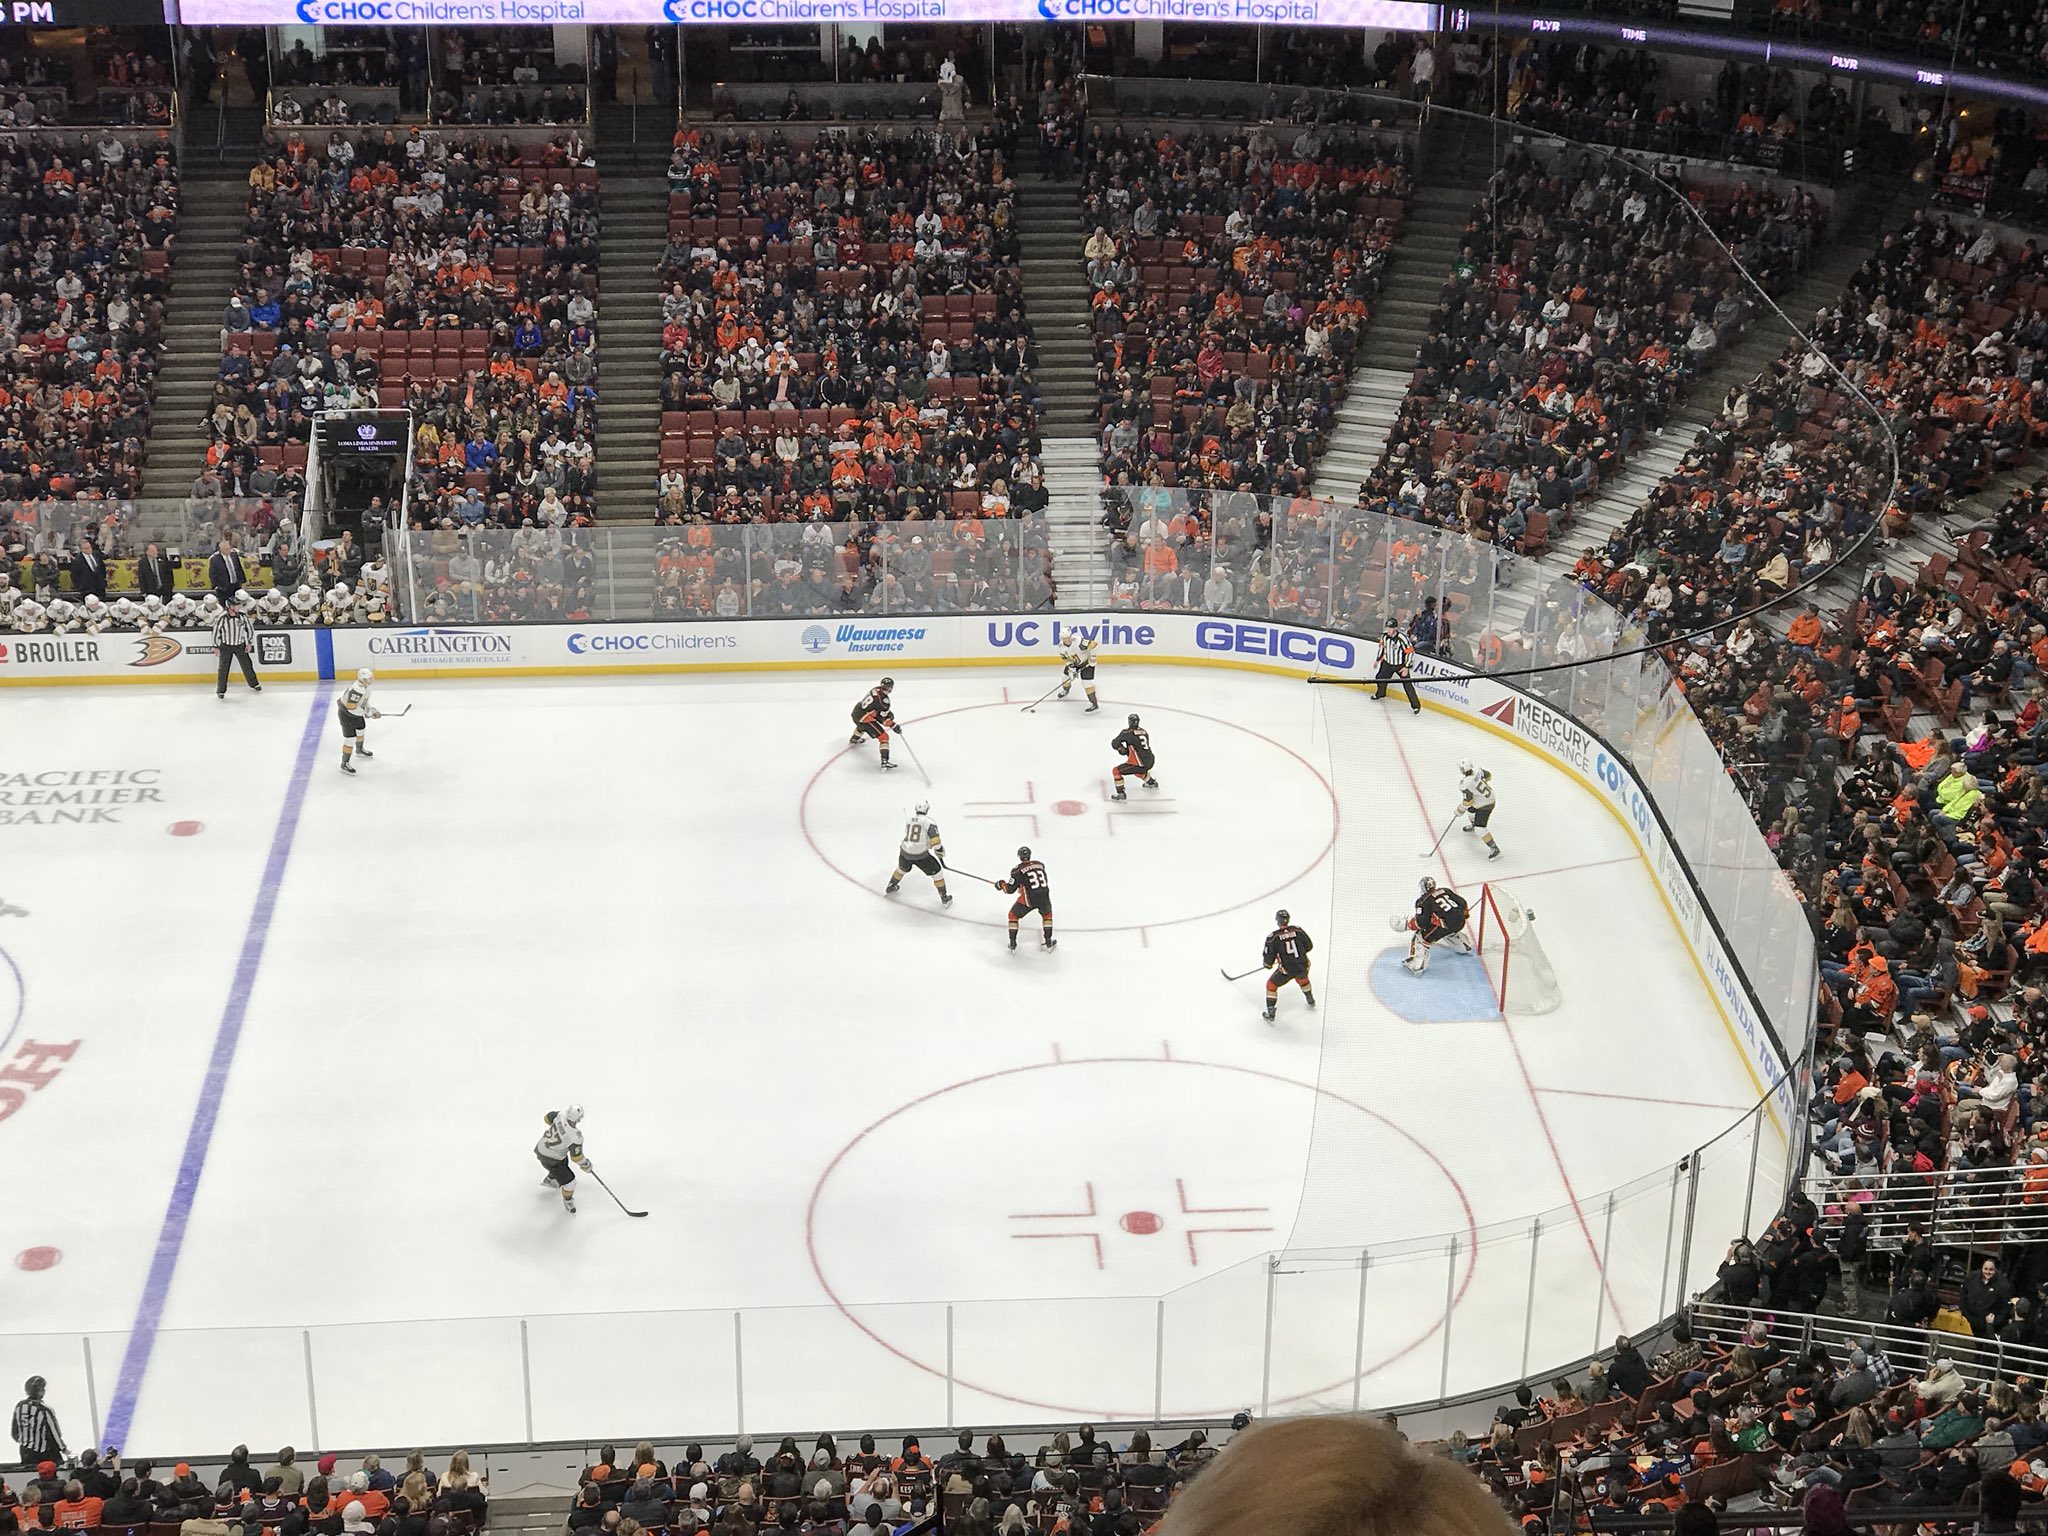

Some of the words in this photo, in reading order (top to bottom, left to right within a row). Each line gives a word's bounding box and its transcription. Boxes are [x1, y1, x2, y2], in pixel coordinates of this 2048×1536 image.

[13, 2, 54, 22] PM
[324, 2, 393, 19] CHOC
[395, 1, 495, 20] Children's
[501, 1, 585, 22] Hospital
[691, 0, 757, 18] CHOC
[760, 0, 857, 18] Children's
[863, 0, 946, 19] Hospital
[1066, 0, 1131, 14] CHOC
[1133, 0, 1230, 16] Children's
[1235, 2, 1318, 21] Hospital
[1532, 19, 1560, 32] PLYR
[1621, 28, 1647, 41] TIME
[1831, 55, 1858, 70] PLYR
[1917, 70, 1943, 85] TIME
[262, 637, 285, 647] FOX
[591, 635, 648, 650] CHOC
[651, 634, 737, 650] Children's
[836, 625, 927, 641] Wawanesa
[988, 621, 1040, 647] UC
[16, 641, 100, 663] BROILER
[368, 635, 511, 654] CARRINGTON
[848, 641, 905, 652] Insurance
[1196, 621, 1355, 669] GEICO
[264, 651, 286, 661] GO
[1518, 698, 1591, 754] MERCURY
[1516, 718, 1590, 773] INSURANCE
[1597, 753, 1630, 806] COX
[0, 788, 164, 806] REMIER
[903, 824, 922, 842] 18
[1026, 870, 1047, 889] 33
[1286, 939, 1299, 958] 4
[1715, 957, 1756, 1048] HONDA
